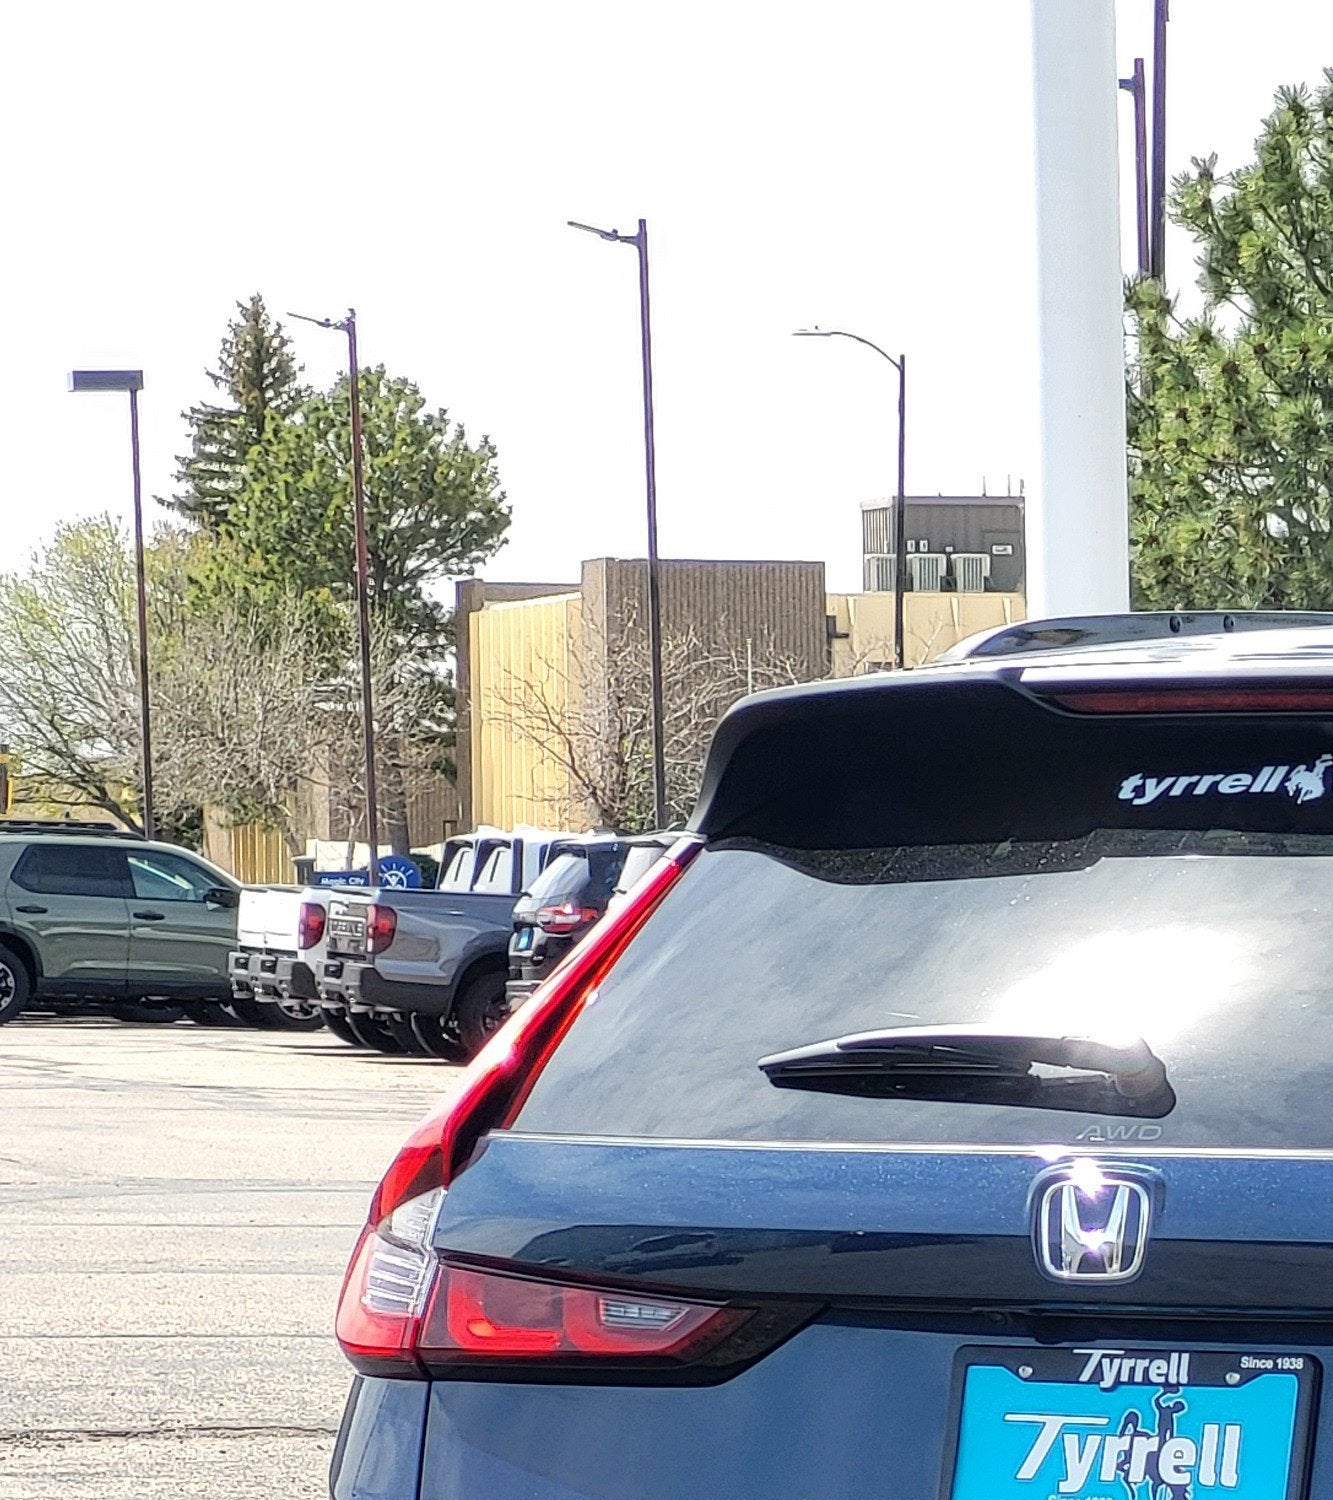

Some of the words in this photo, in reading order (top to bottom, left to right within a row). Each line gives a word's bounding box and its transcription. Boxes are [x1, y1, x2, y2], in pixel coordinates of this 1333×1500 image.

[1075, 1122, 1162, 1143] AWD
[1072, 1348, 1190, 1389] Tyrrell
[1240, 1355, 1274, 1370] Since
[1275, 1356, 1304, 1371] 1938
[1004, 1412, 1243, 1495] Tyrrell
